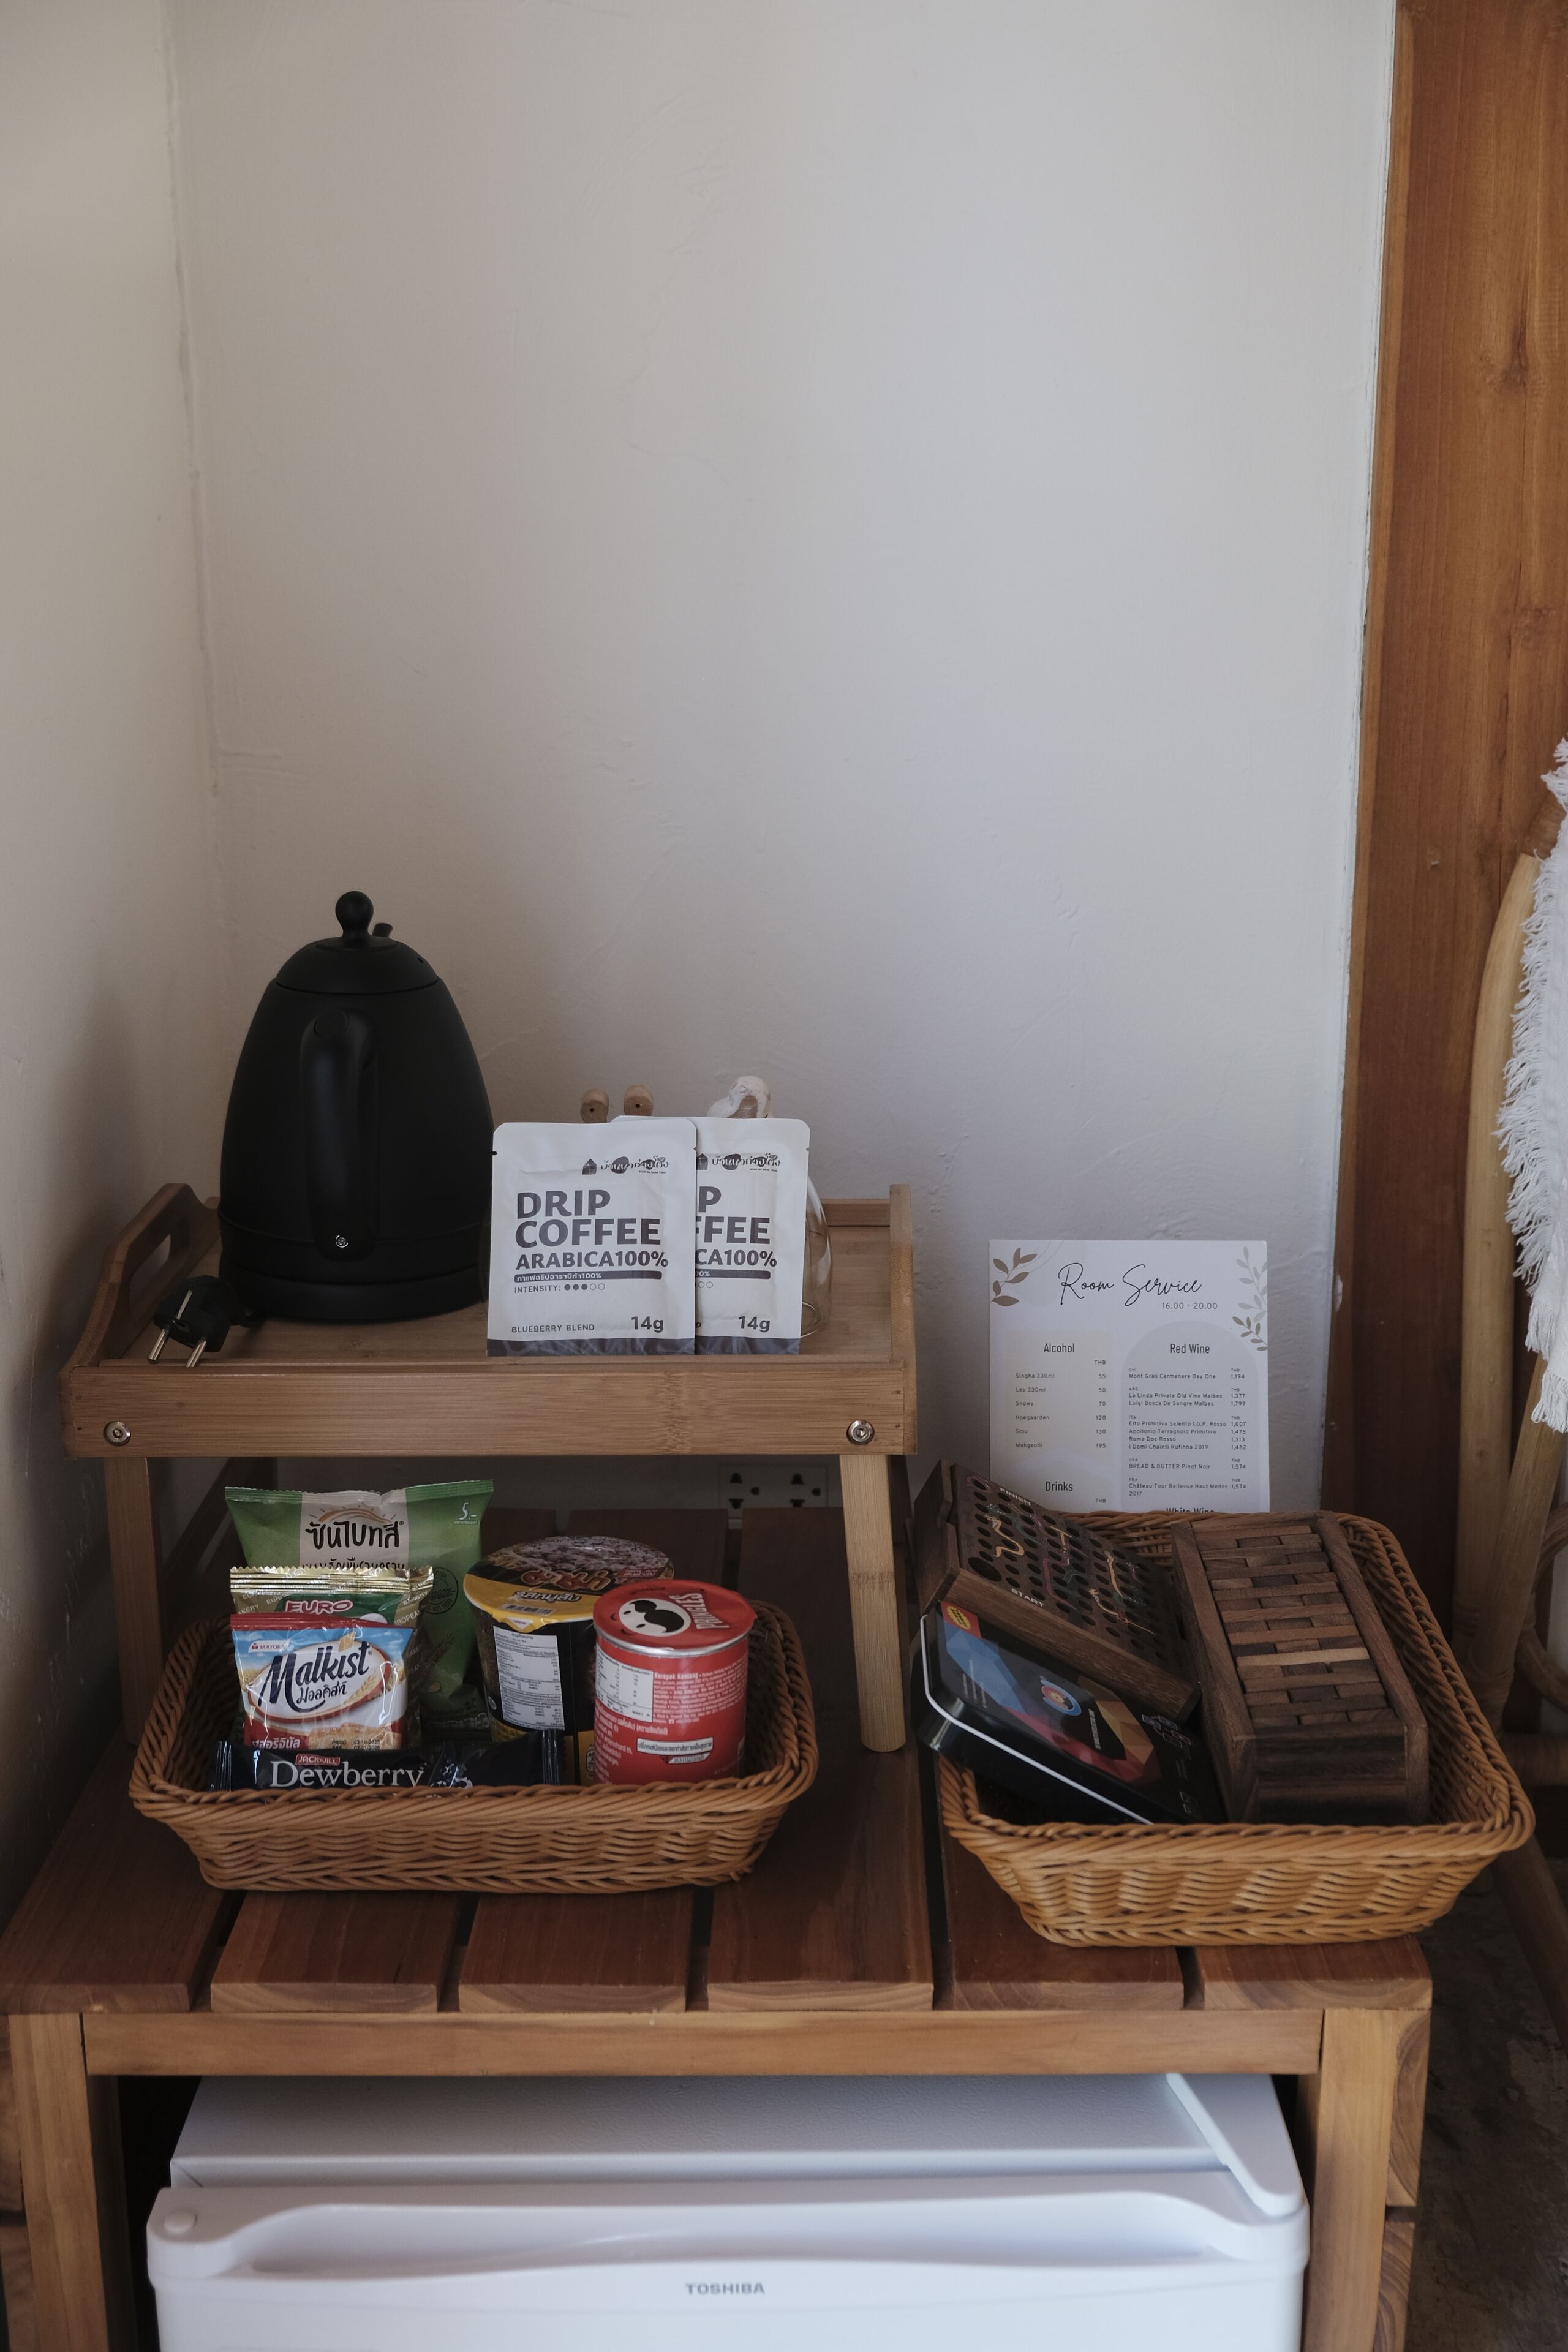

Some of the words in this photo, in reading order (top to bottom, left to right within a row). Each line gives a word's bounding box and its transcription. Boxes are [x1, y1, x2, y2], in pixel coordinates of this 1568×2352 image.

[517, 1189, 611, 1219] DRIP
[515, 1218, 662, 1248] COFFEE
[696, 1216, 771, 1244] FEE
[516, 1250, 669, 1270] ARABICA100%
[695, 1249, 777, 1267] CA100%
[514, 1284, 561, 1294] INTENSITY:
[1058, 1262, 1114, 1306] Room
[1123, 1264, 1202, 1306] Service
[511, 1324, 563, 1333] BLUEBERRY
[631, 1316, 664, 1333] 14g
[738, 1316, 771, 1332] 14g
[1044, 1343, 1075, 1353] Alcohol
[1170, 1344, 1186, 1354] Red
[1189, 1344, 1210, 1354] Wine
[1046, 1481, 1073, 1491] Drinks
[1000, 1487, 1031, 1506] FINISH
[1011, 1588, 1044, 1607] START
[238, 1604, 258, 1615] AKERY
[285, 1600, 353, 1614] EURO
[669, 1593, 730, 1629] PRINGLES
[258, 1641, 371, 1713] Malkist
[270, 1760, 426, 1787] Dewberry
[685, 2283, 765, 2295] TOSHIBA
